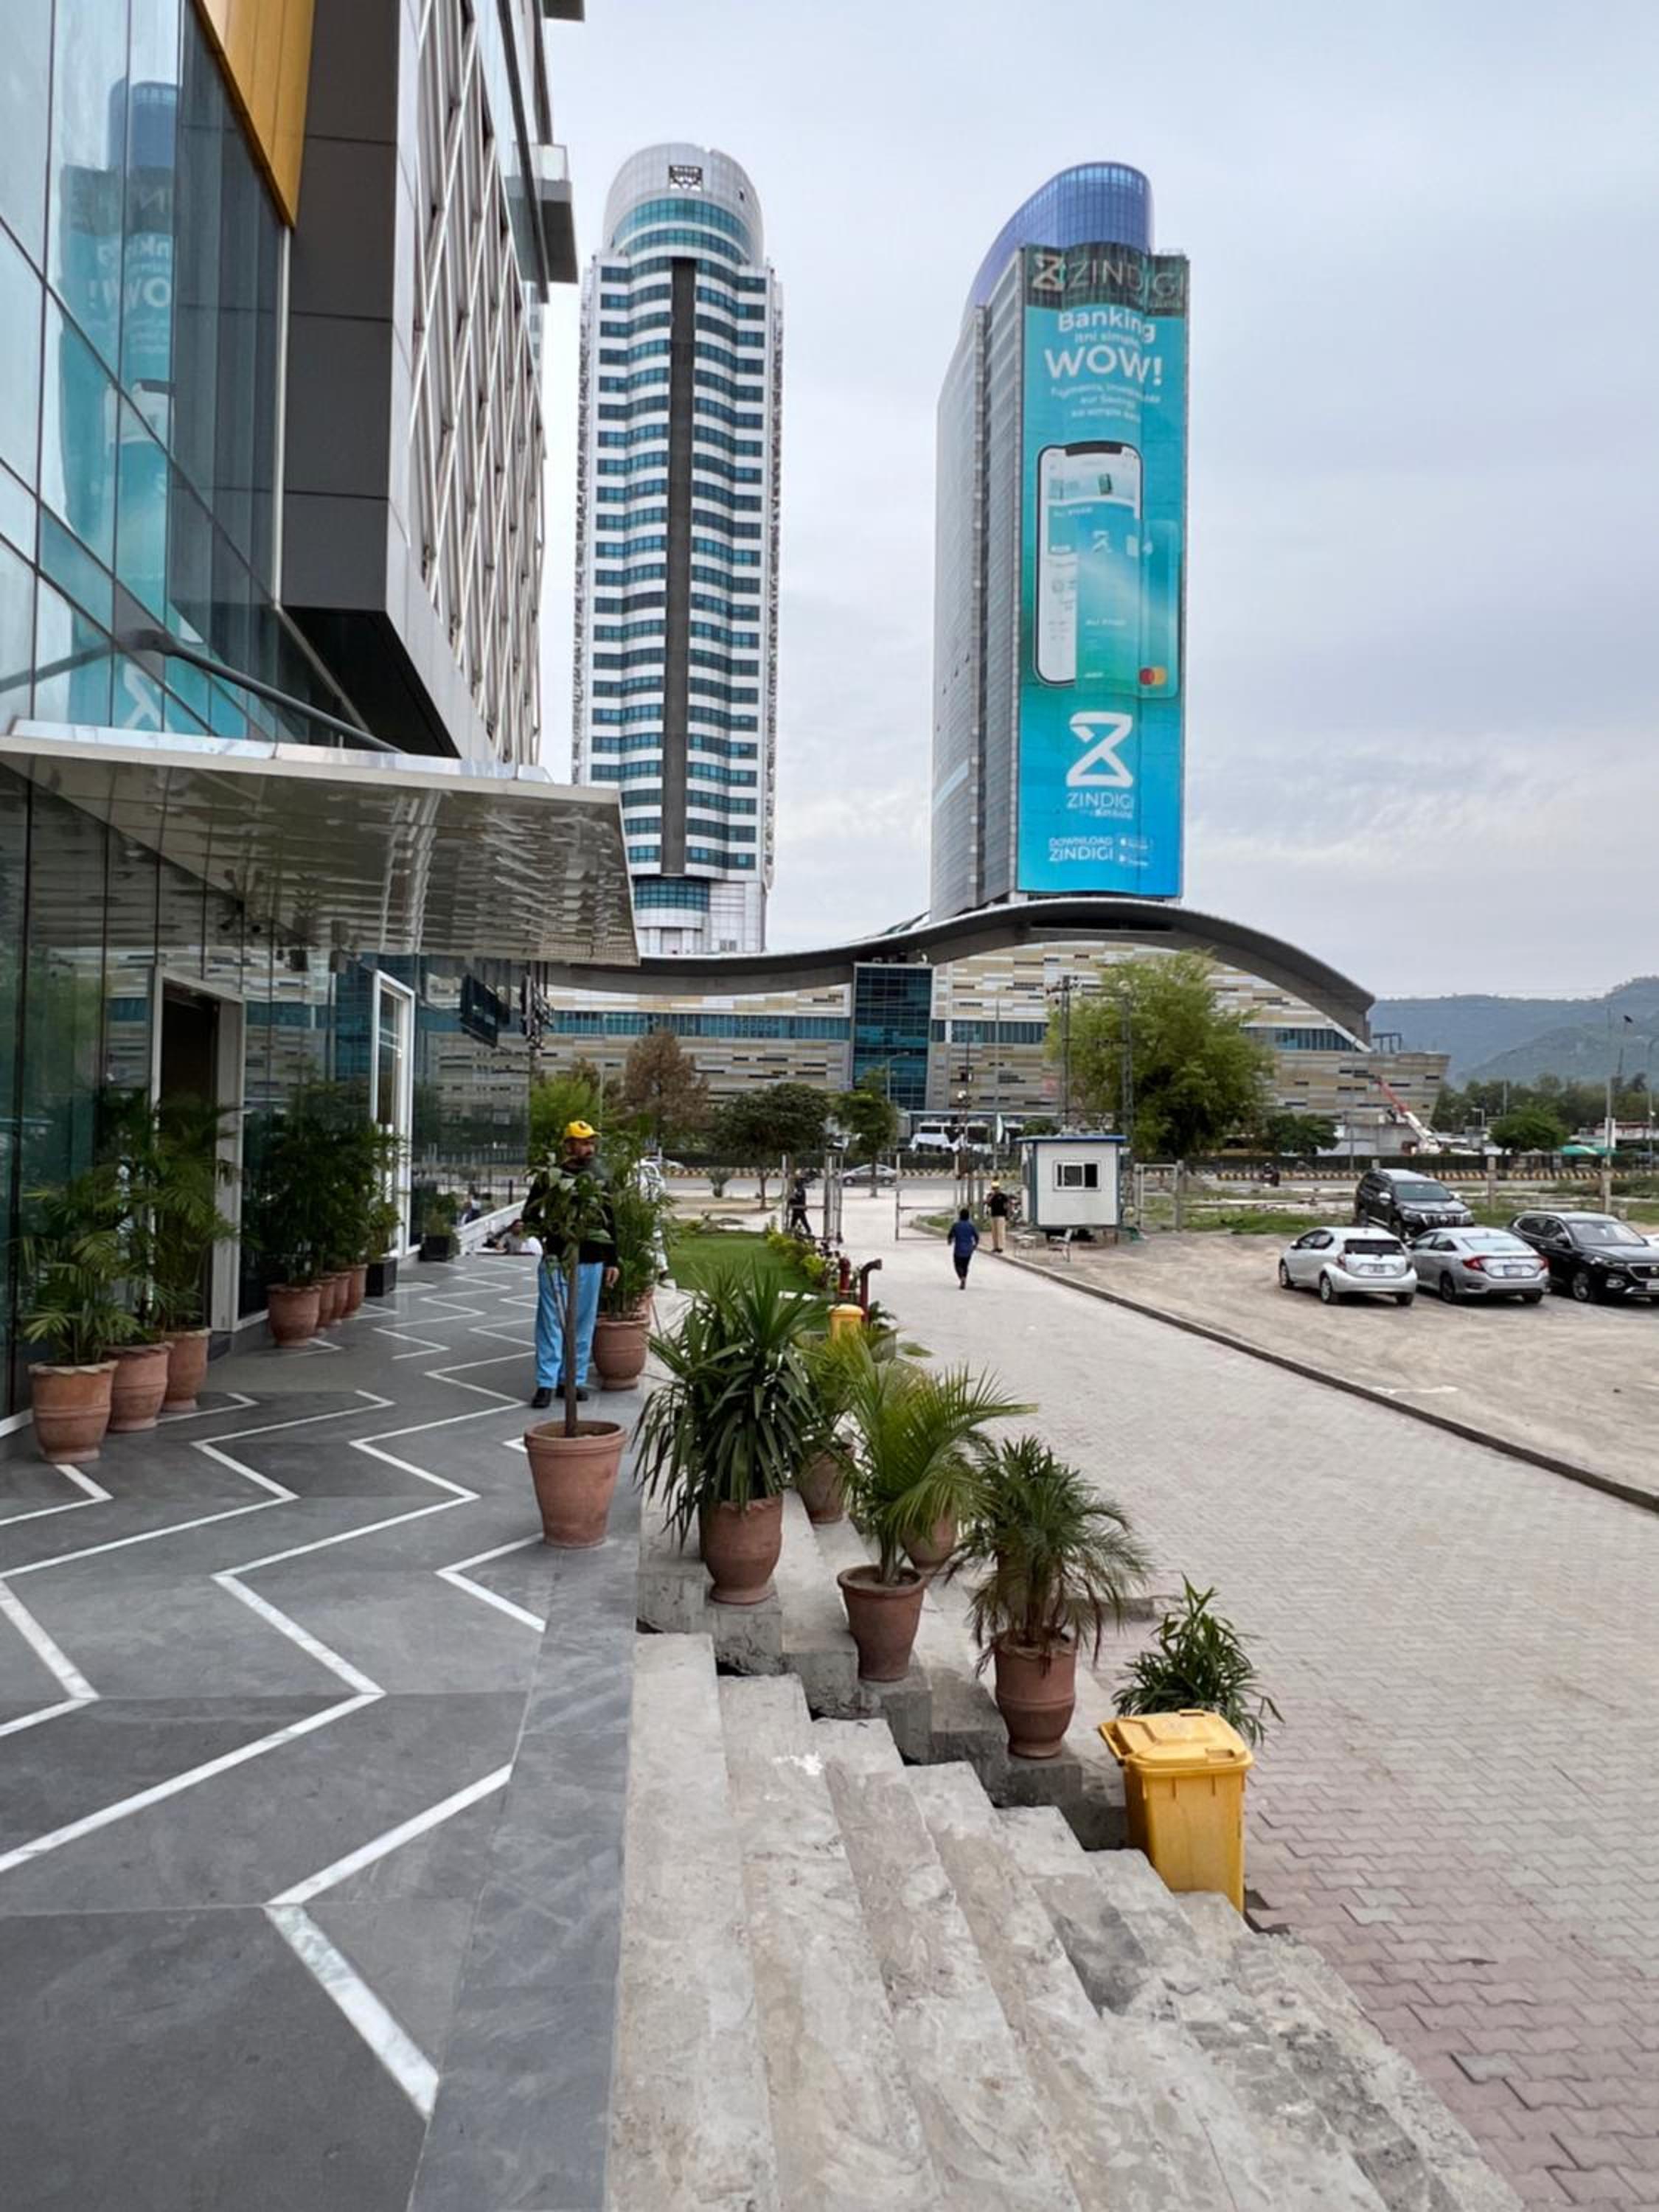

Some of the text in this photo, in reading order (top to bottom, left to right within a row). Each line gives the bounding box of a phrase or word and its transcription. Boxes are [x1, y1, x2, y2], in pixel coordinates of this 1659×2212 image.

[1070, 259, 1184, 296] ZINDIGI
[1058, 306, 1155, 344] Banking
[1044, 344, 1163, 386] WOW!
